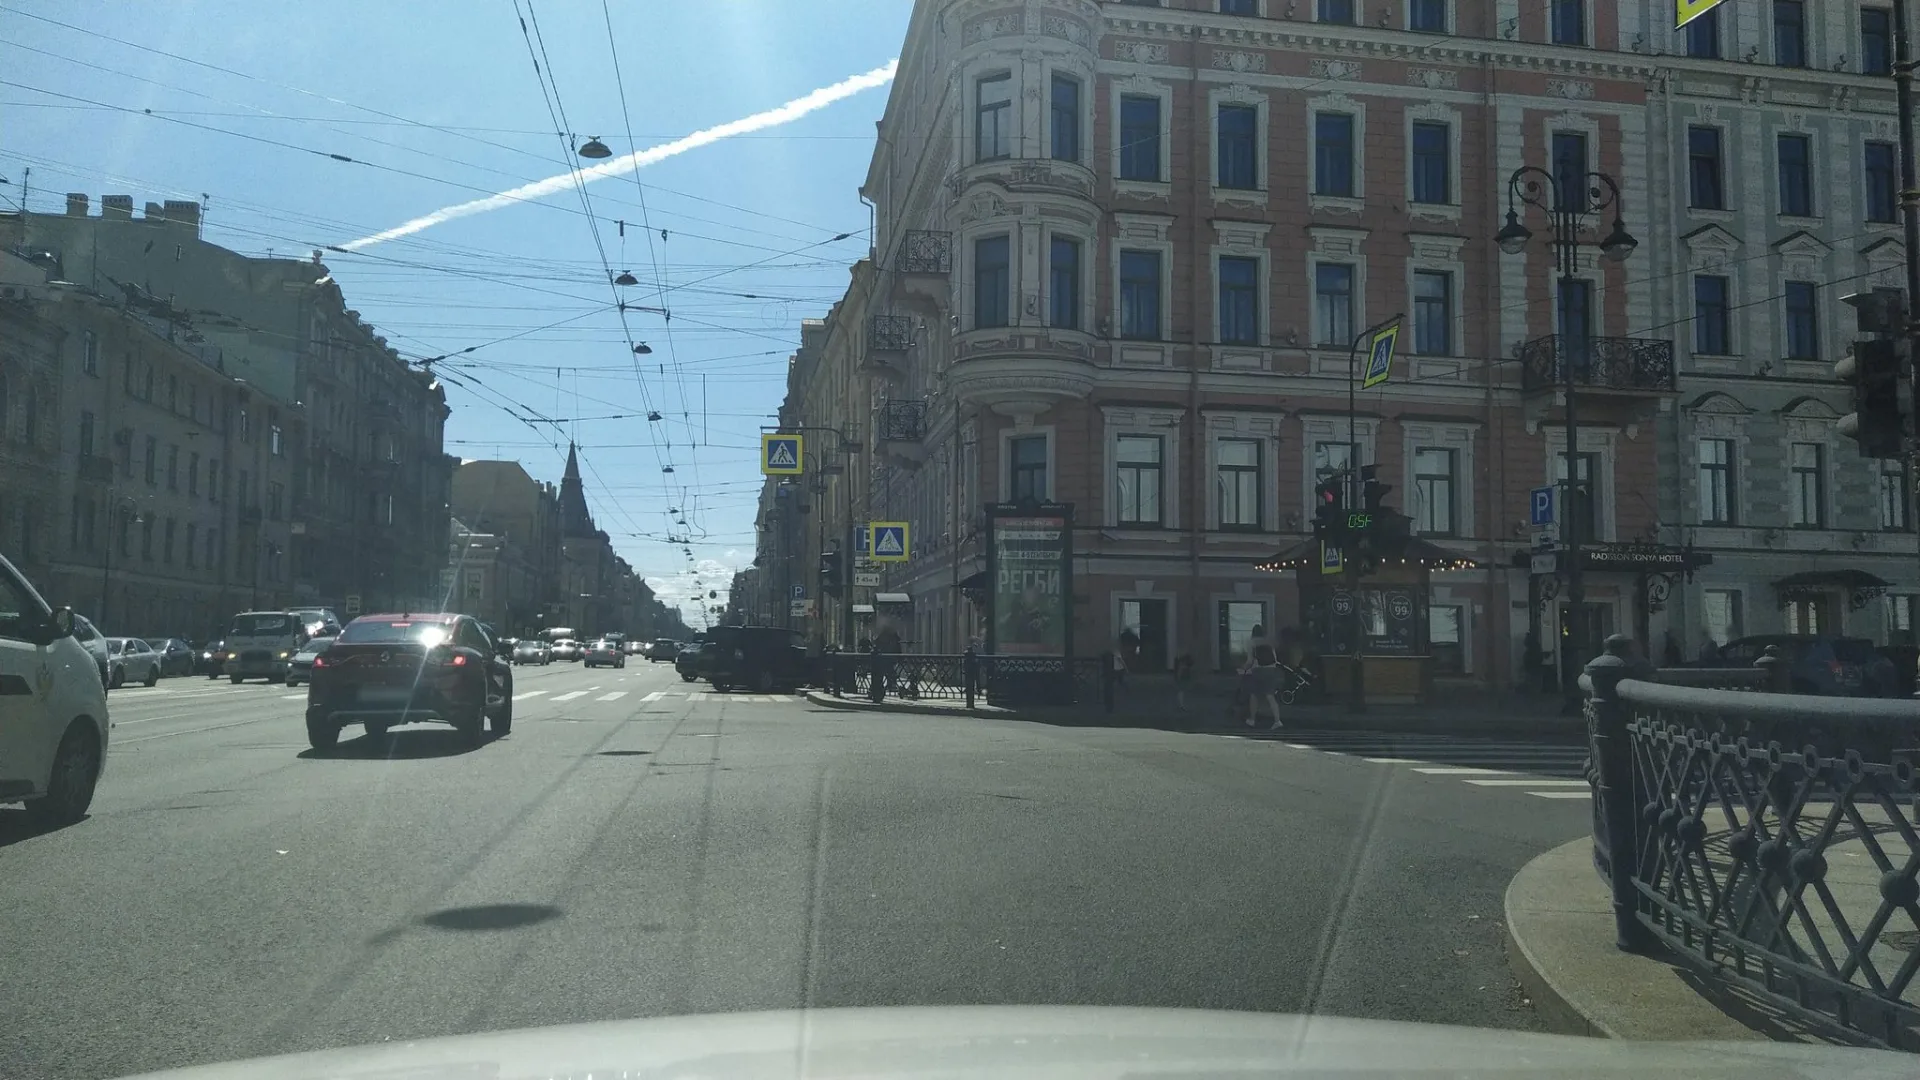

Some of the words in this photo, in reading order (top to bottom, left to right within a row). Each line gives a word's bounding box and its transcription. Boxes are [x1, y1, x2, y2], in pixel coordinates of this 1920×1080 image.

[1590, 552, 1630, 561] RADISSON
[1632, 553, 1658, 562] SONYA
[1659, 554, 1684, 563] HOTEL
[998, 569, 1060, 594] РЕГБИ
[1336, 602, 1349, 611] 99
[1394, 606, 1408, 616] 99
